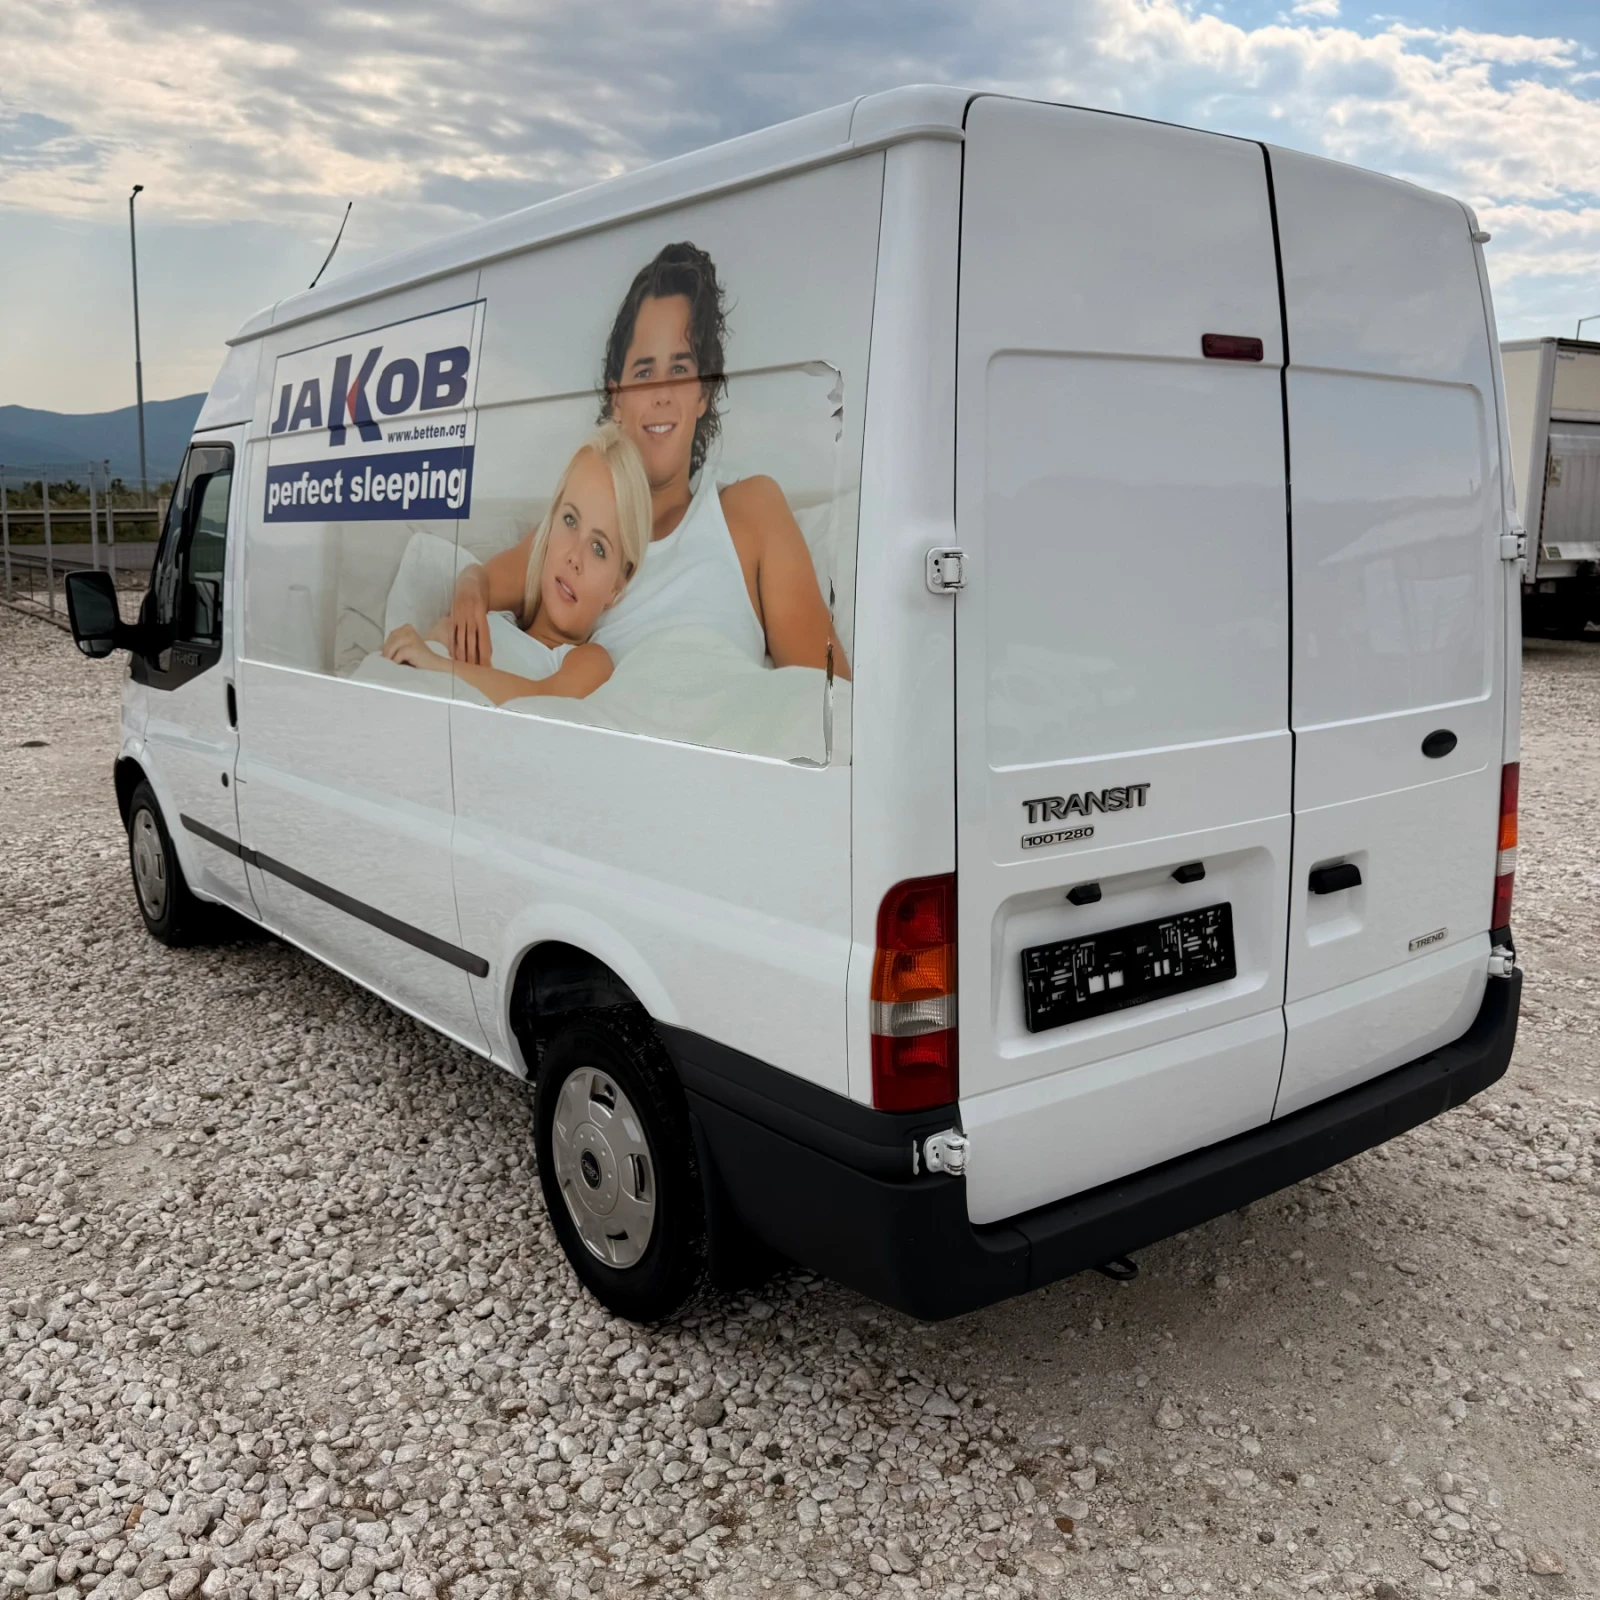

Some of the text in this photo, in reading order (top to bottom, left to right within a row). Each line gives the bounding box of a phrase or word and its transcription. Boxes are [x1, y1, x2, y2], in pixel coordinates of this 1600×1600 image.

[271, 346, 471, 447] JAKOB
[387, 423, 466, 443] www.betten.org
[268, 461, 467, 514] perfect sleeping
[1022, 783, 1151, 824] TRANSIT
[1415, 932, 1444, 948] TREND
